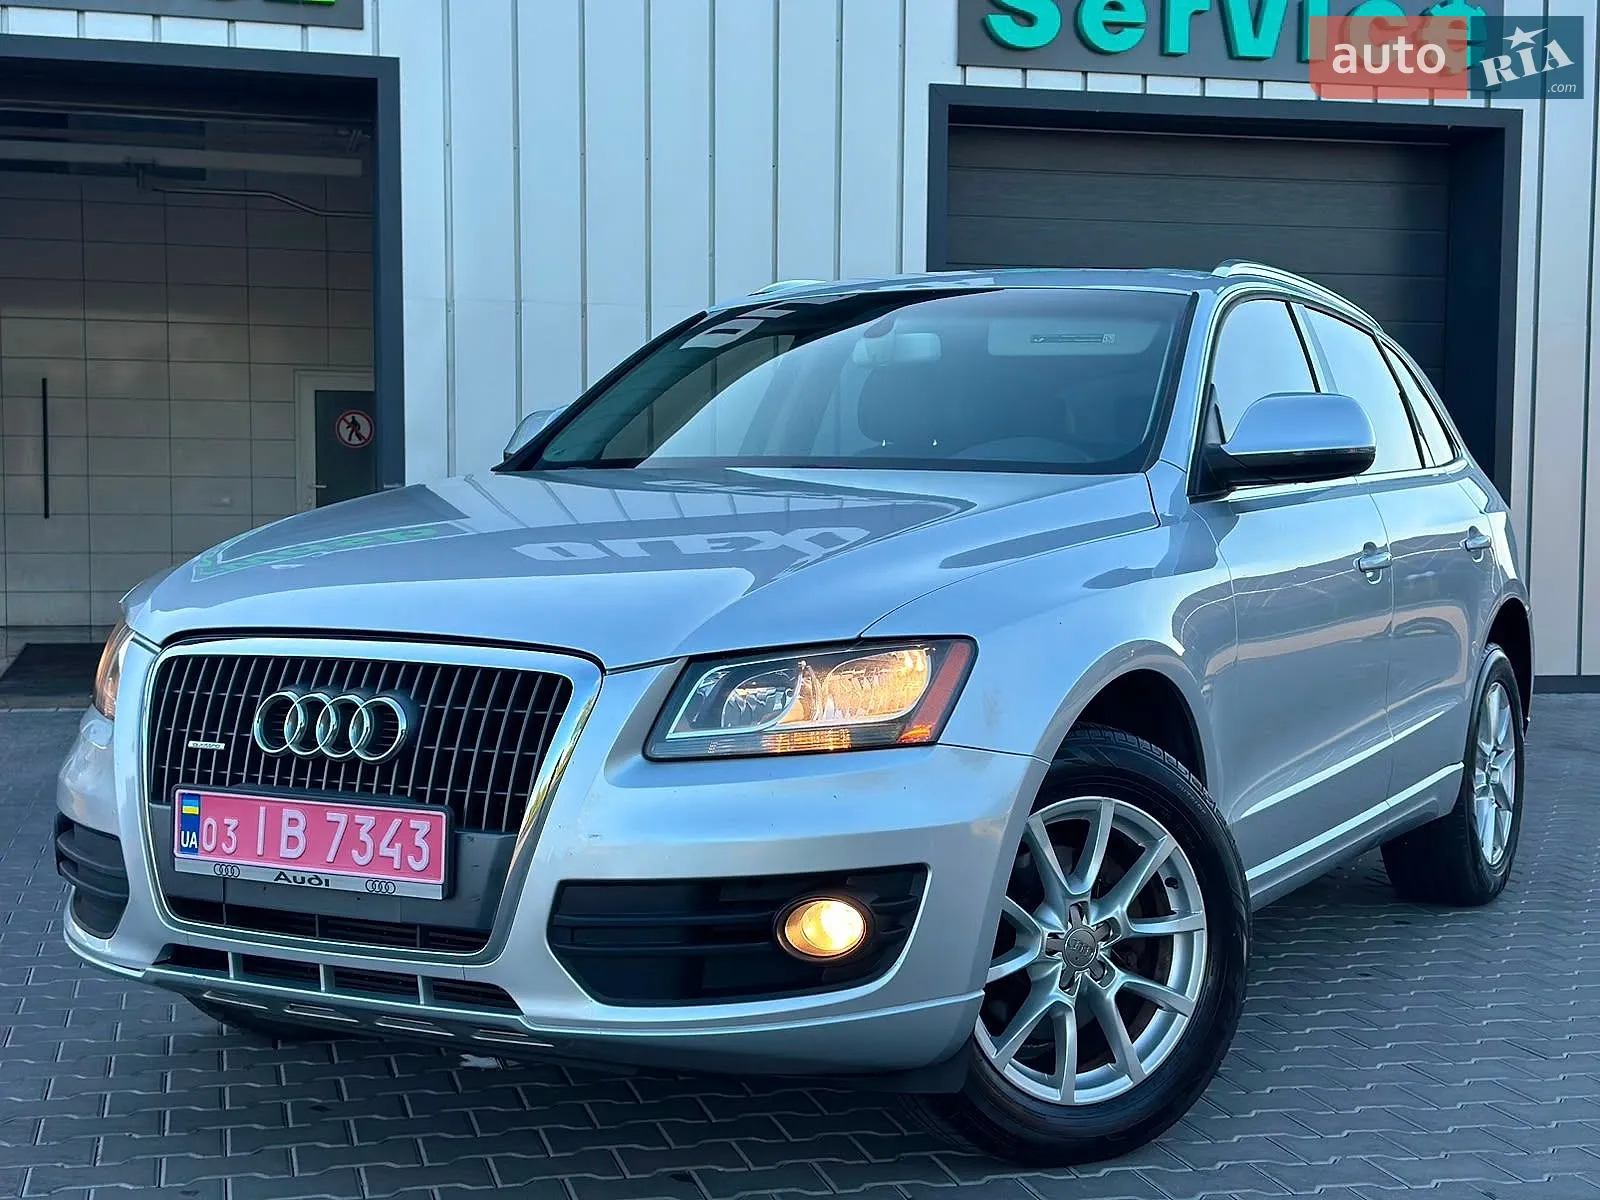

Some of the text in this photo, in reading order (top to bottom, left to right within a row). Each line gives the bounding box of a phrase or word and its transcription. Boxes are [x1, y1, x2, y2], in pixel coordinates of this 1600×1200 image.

[180, 830, 198, 849] UA
[202, 806, 431, 872] 03 IB 7343
[273, 871, 330, 887] Audi
